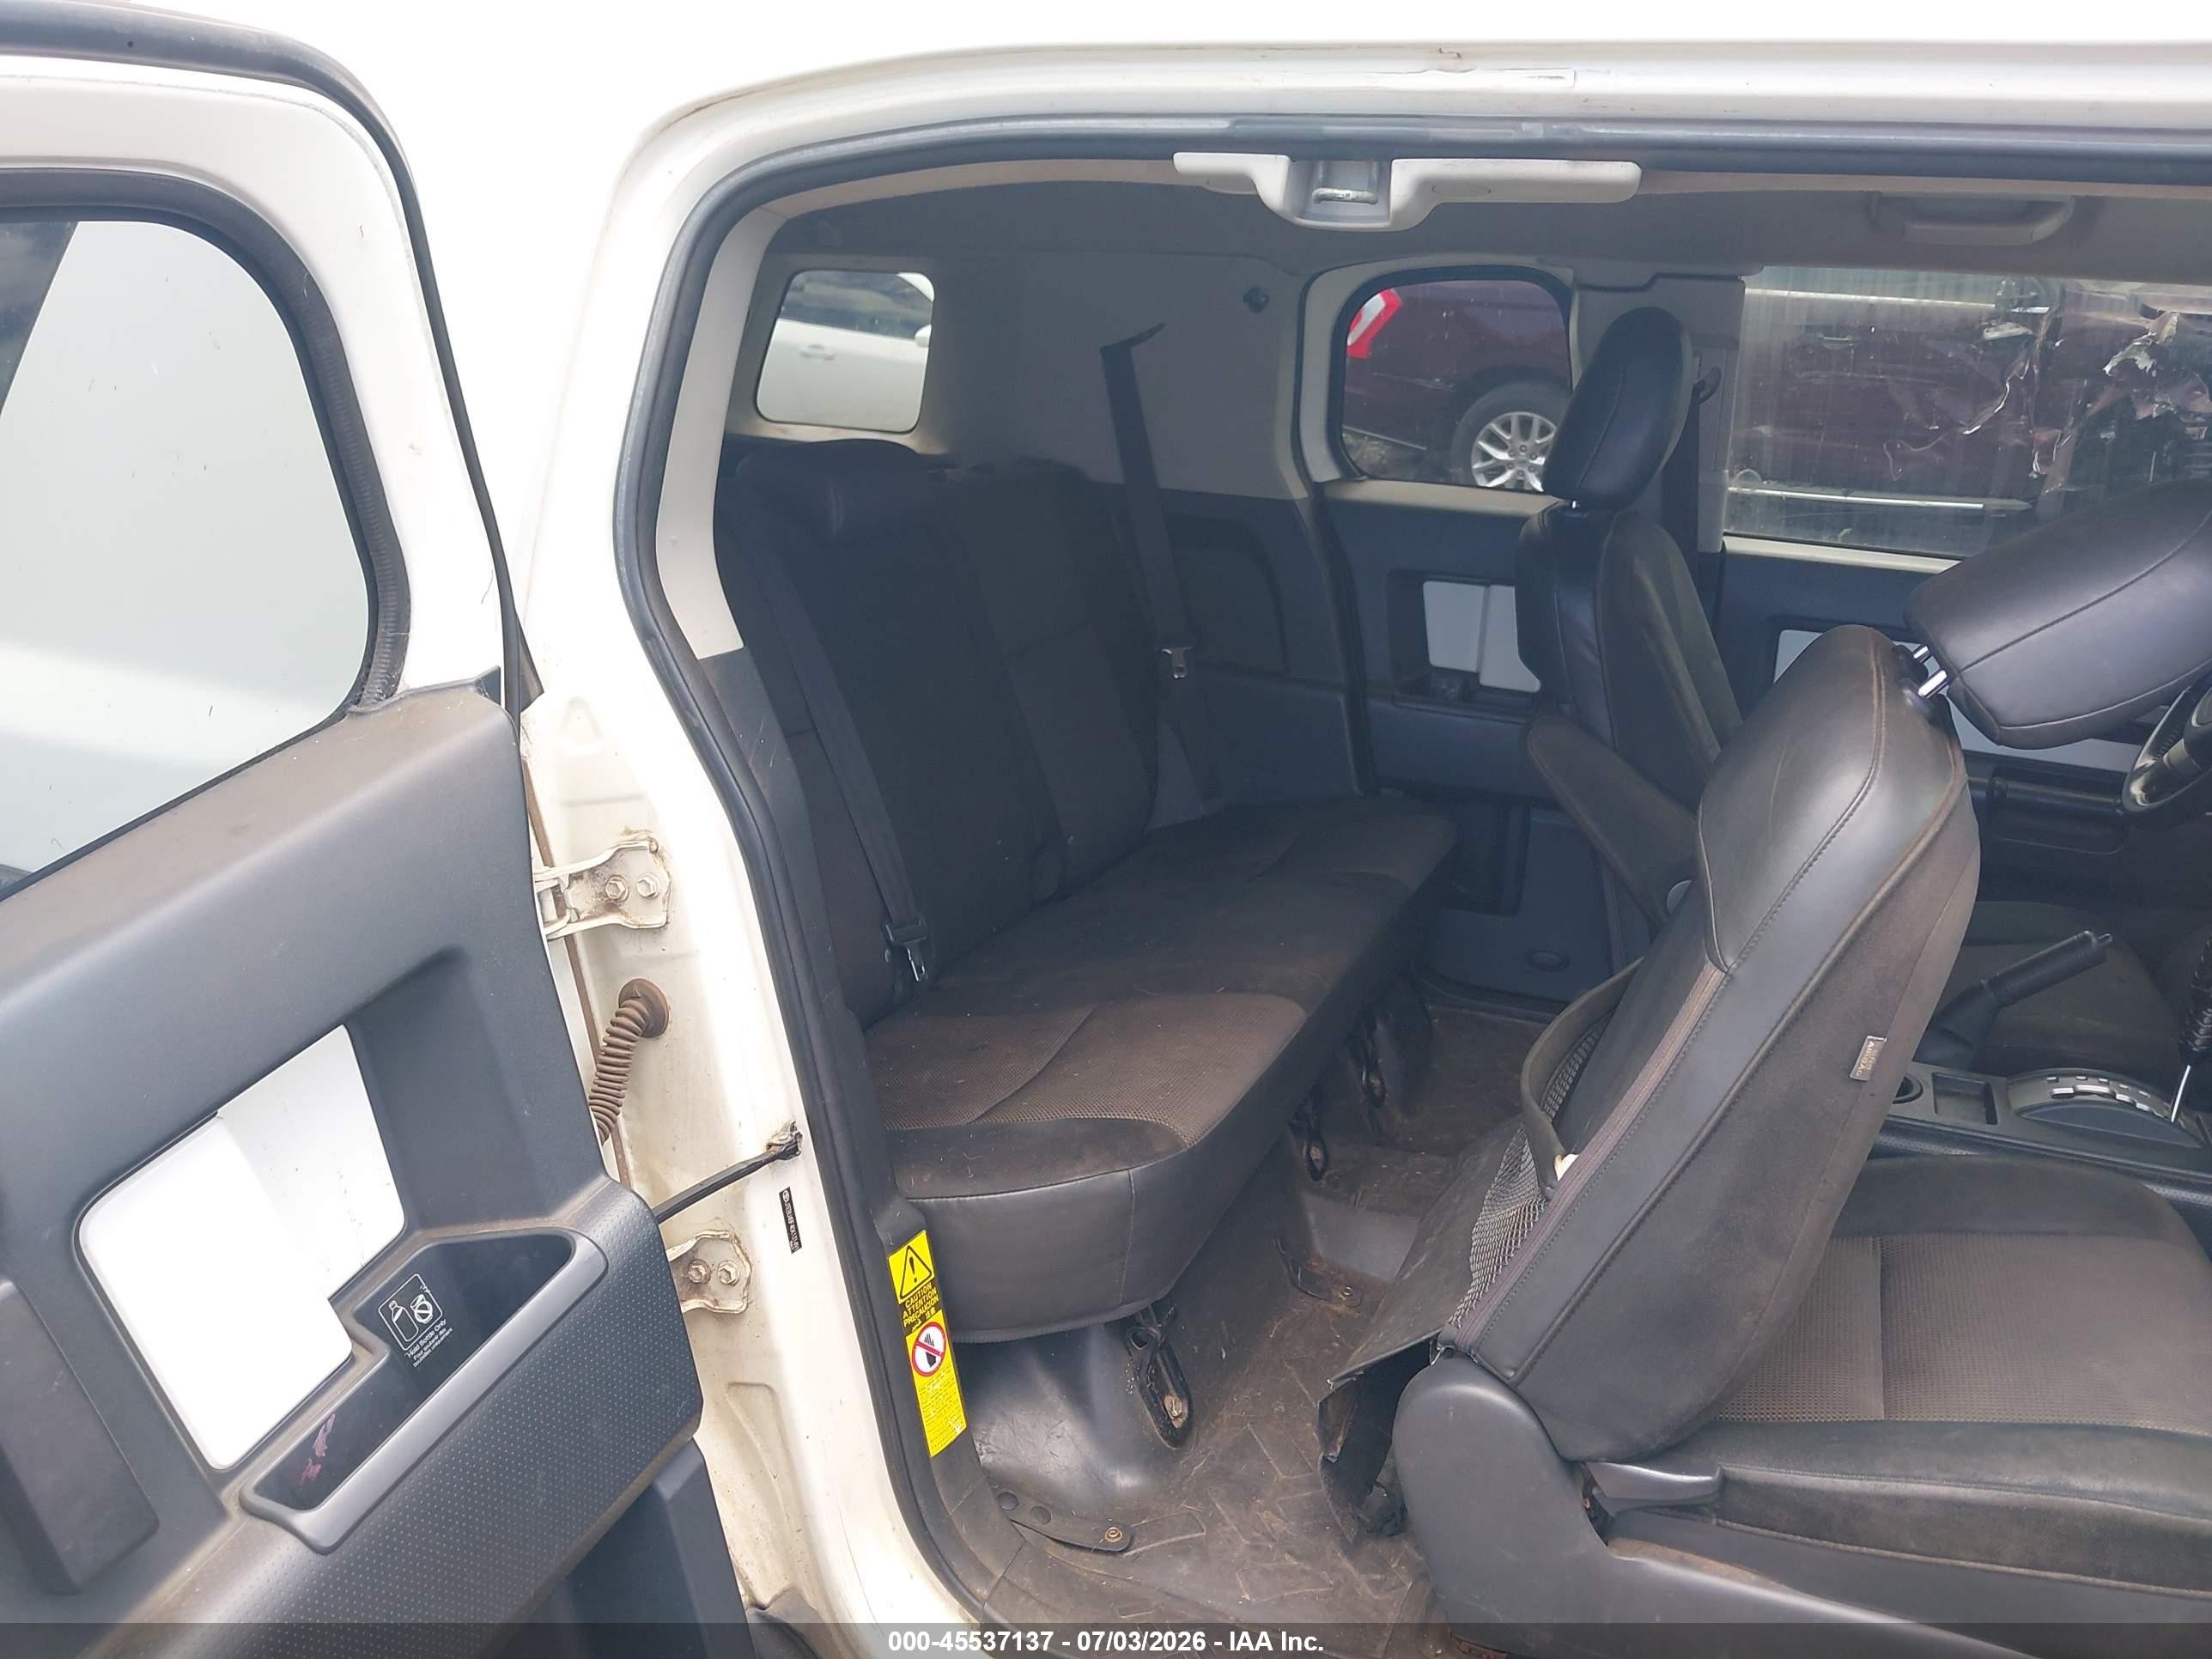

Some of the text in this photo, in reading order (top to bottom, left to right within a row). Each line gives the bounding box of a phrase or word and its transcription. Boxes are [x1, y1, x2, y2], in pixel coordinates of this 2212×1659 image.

[903, 1286, 937, 1320] ATTENTION
[905, 1282, 932, 1309] CAUTION
[419, 1330, 434, 1346] Bottle
[434, 1319, 447, 1332] Only
